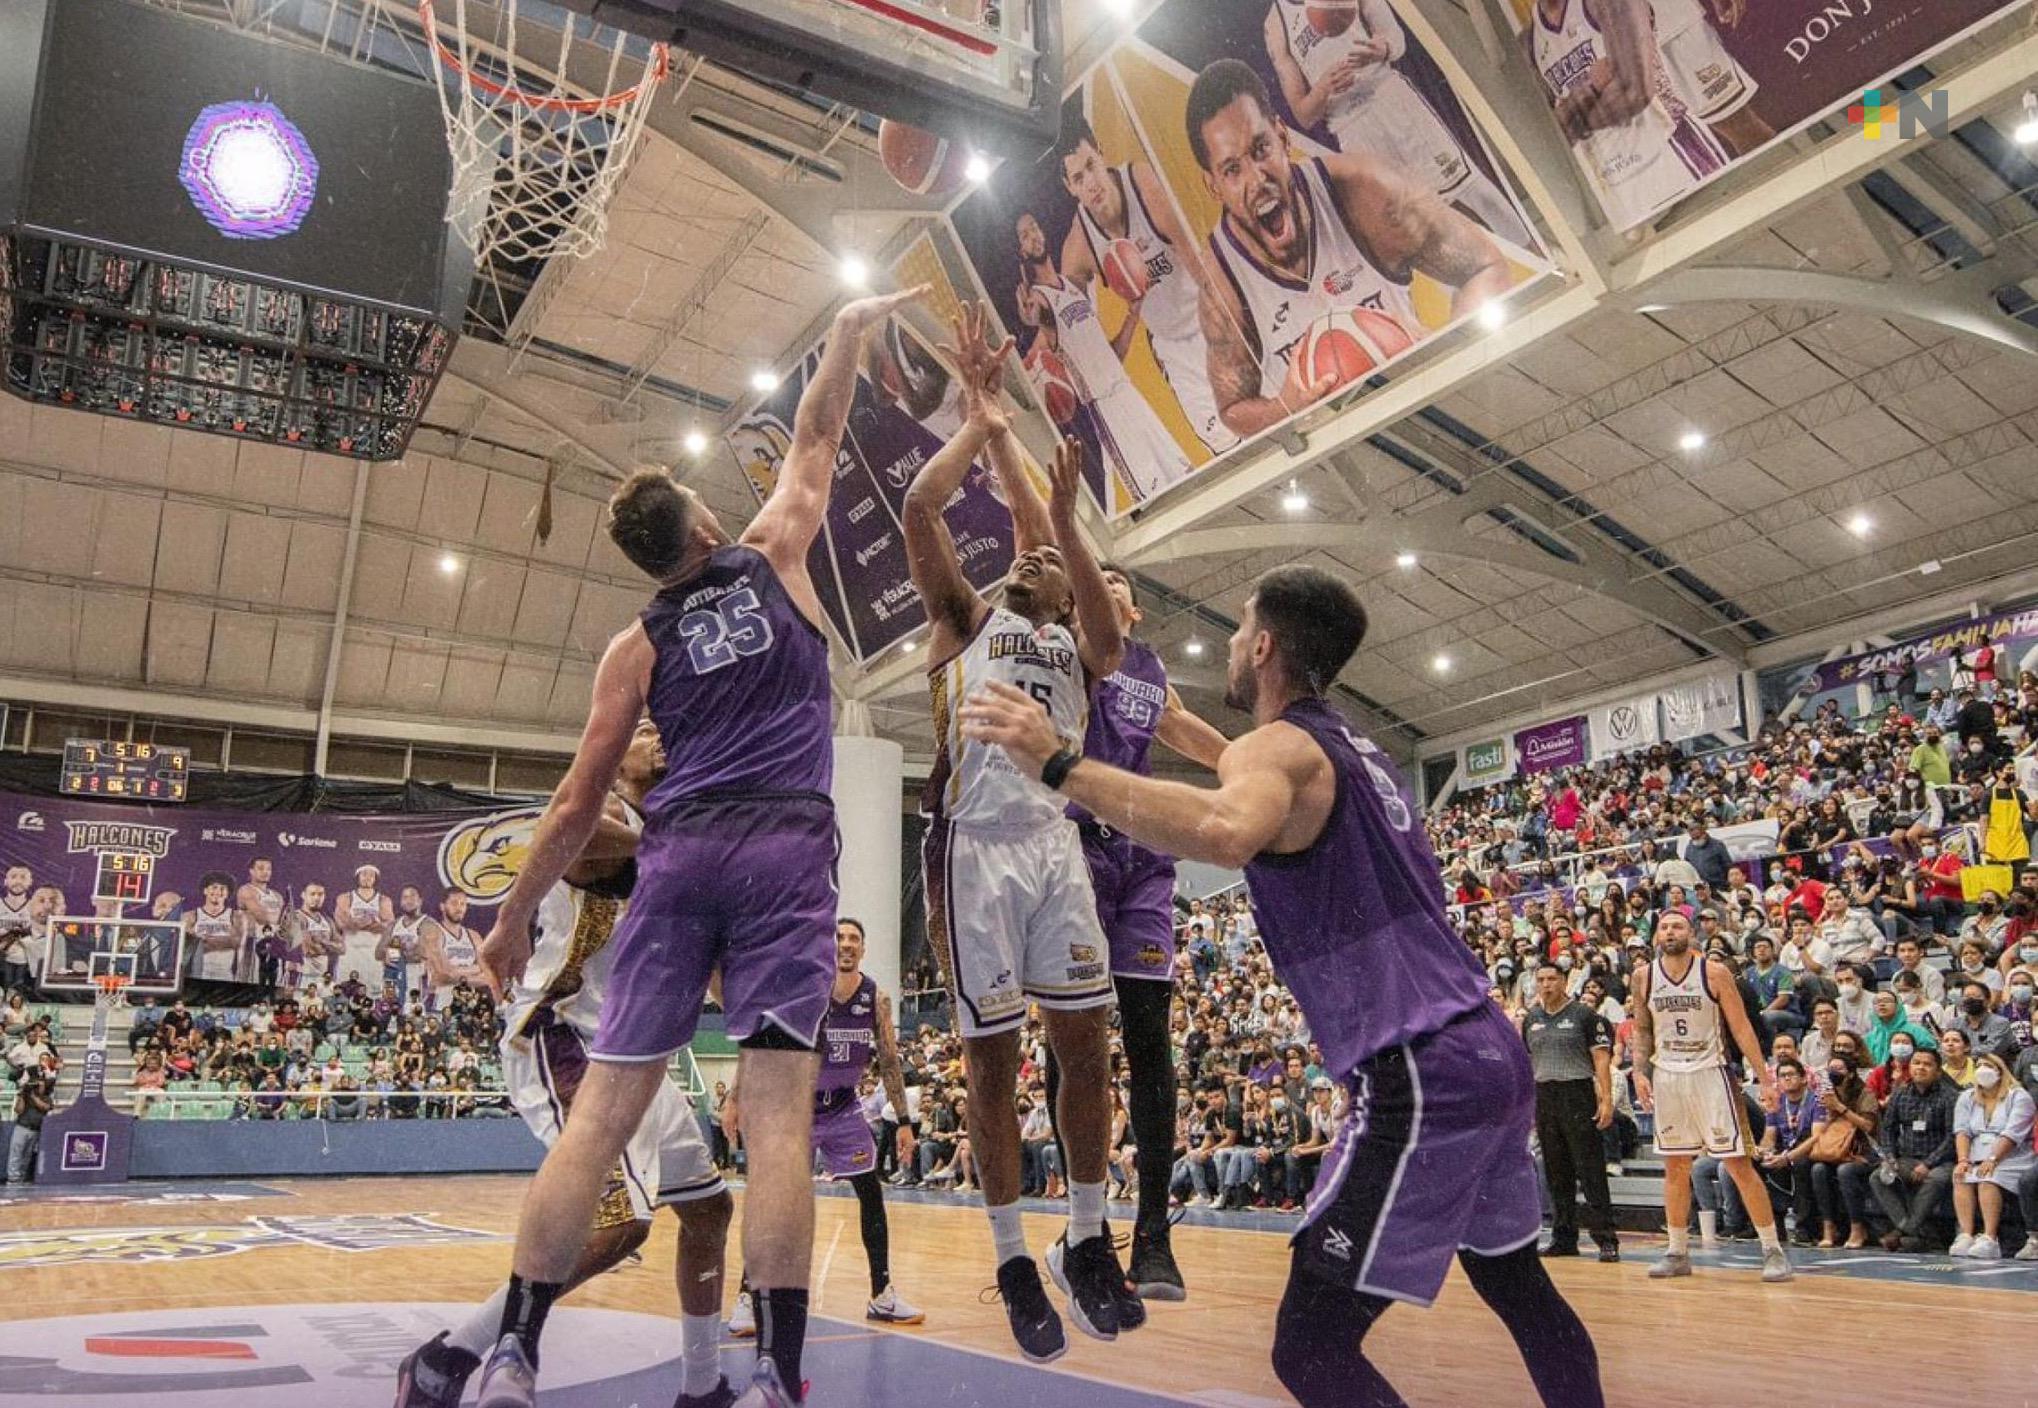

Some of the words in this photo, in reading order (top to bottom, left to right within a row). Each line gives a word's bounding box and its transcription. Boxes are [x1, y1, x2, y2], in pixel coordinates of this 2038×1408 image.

[1783, 0, 1853, 64] DON
[678, 587, 774, 675] 25
[115, 742, 125, 757] 5
[71, 824, 166, 854] HALCONES
[113, 855, 123, 869] 5
[135, 855, 149, 871] 16
[116, 874, 142, 899] 14
[1676, 1018, 1688, 1036] 6
